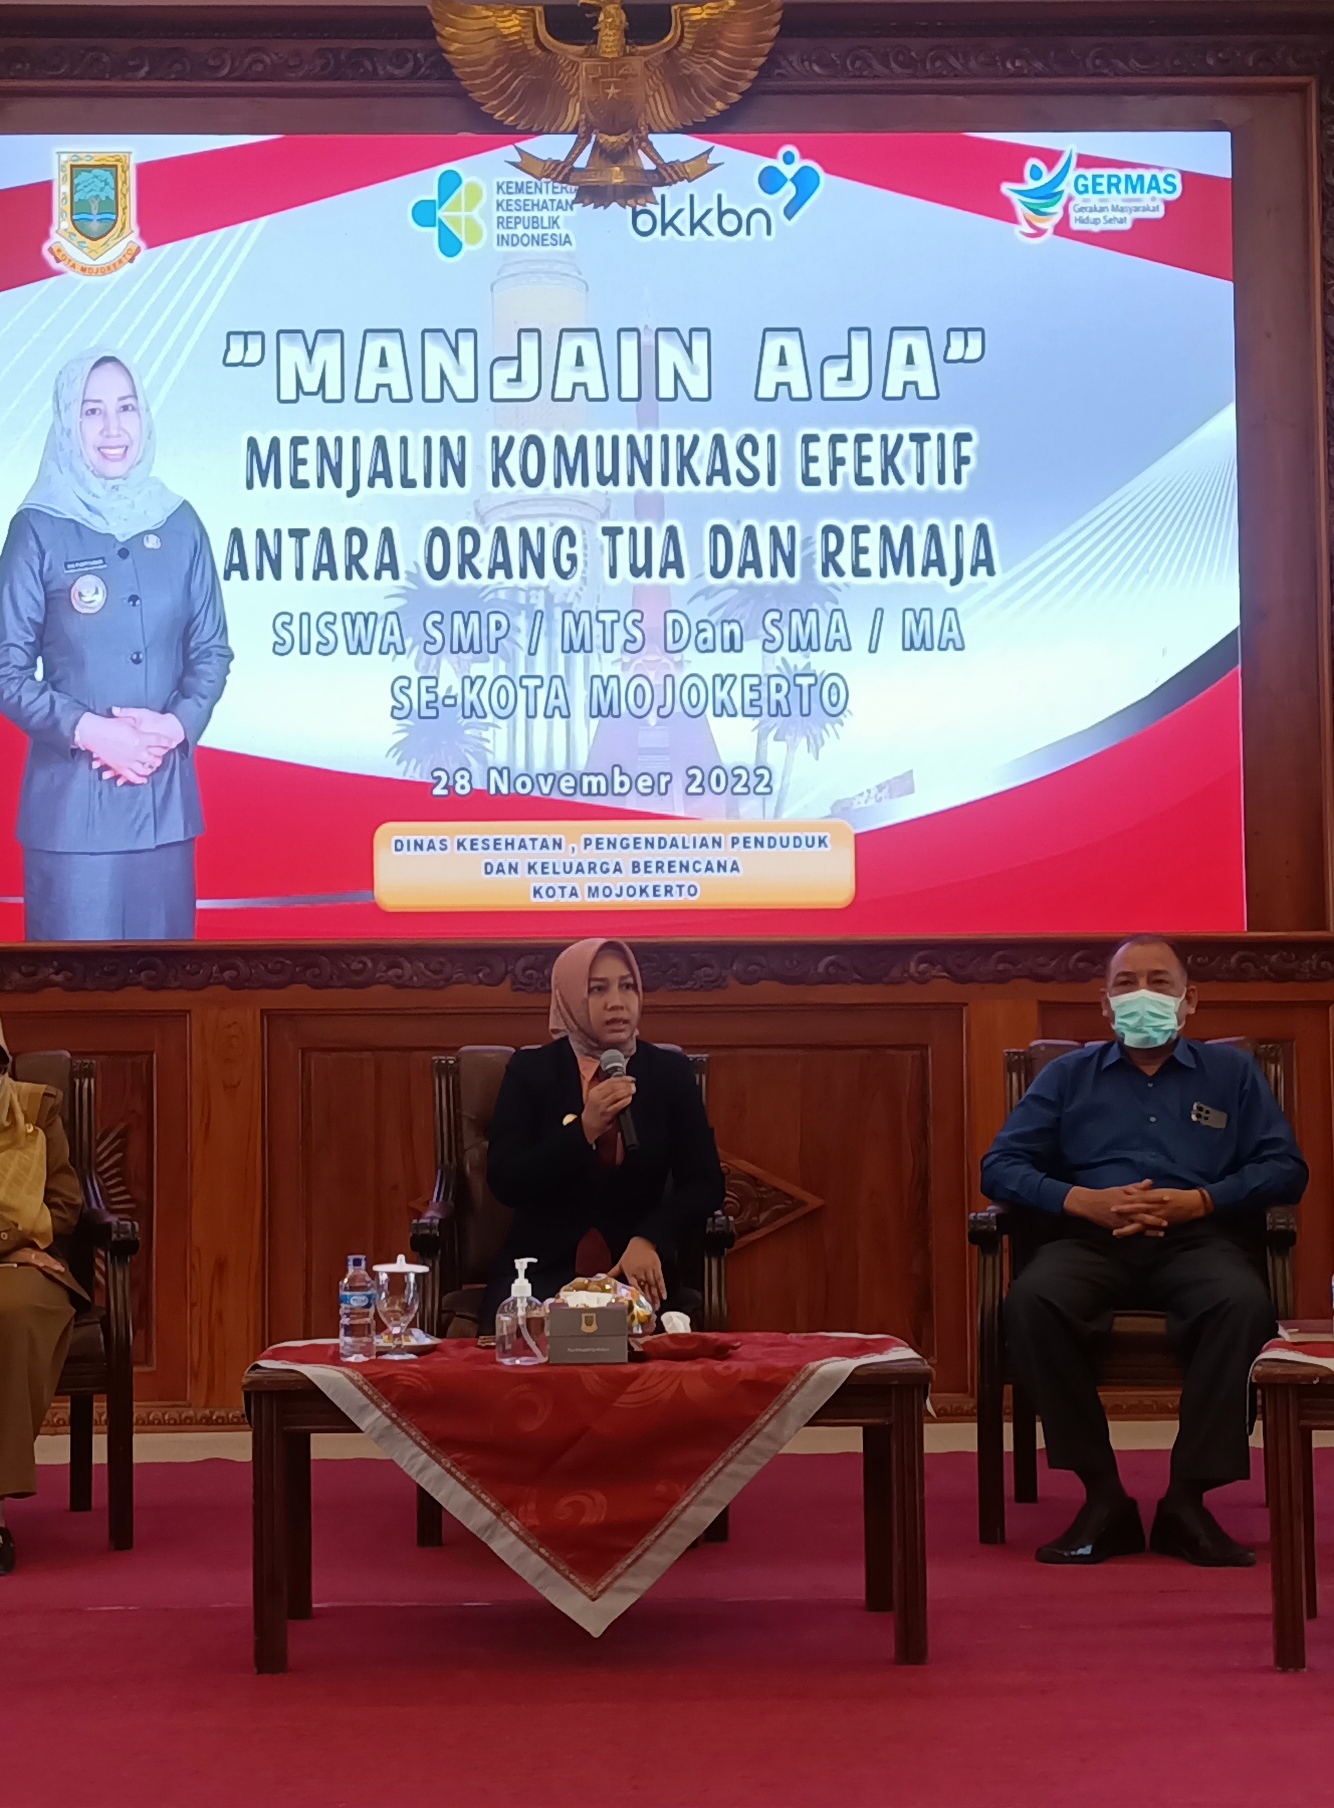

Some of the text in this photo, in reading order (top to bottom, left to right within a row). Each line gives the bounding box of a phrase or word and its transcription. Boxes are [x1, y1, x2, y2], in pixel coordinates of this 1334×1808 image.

[496, 181, 578, 195] KEMENTERI
[1073, 174, 1178, 195] GERMAS
[496, 198, 574, 212] KESEHATAN
[496, 215, 561, 230] REPUBLIK
[631, 193, 772, 238] bkkbn
[496, 232, 573, 247] INDONESIA
[245, 432, 973, 499] MENJALIN KOMUNIKASI EFEKTIF
[222, 522, 997, 587] ANTARA ORANG TUA DAN REMAJA
[271, 607, 966, 657] SISWA SMP / MTS Dan SMA / MA
[389, 672, 851, 721] SE-KOTA MOJOKERTO
[430, 763, 774, 798] 28 November 2022
[393, 837, 450, 853] DINAS
[455, 836, 564, 852] KESEHATAN
[582, 835, 723, 851] PENGENDALIAN
[730, 834, 830, 850] PENDUDUK
[483, 859, 741, 875] DAN KELUARGA BERENCANA
[532, 883, 699, 899] KOTA MOJOKERTO
